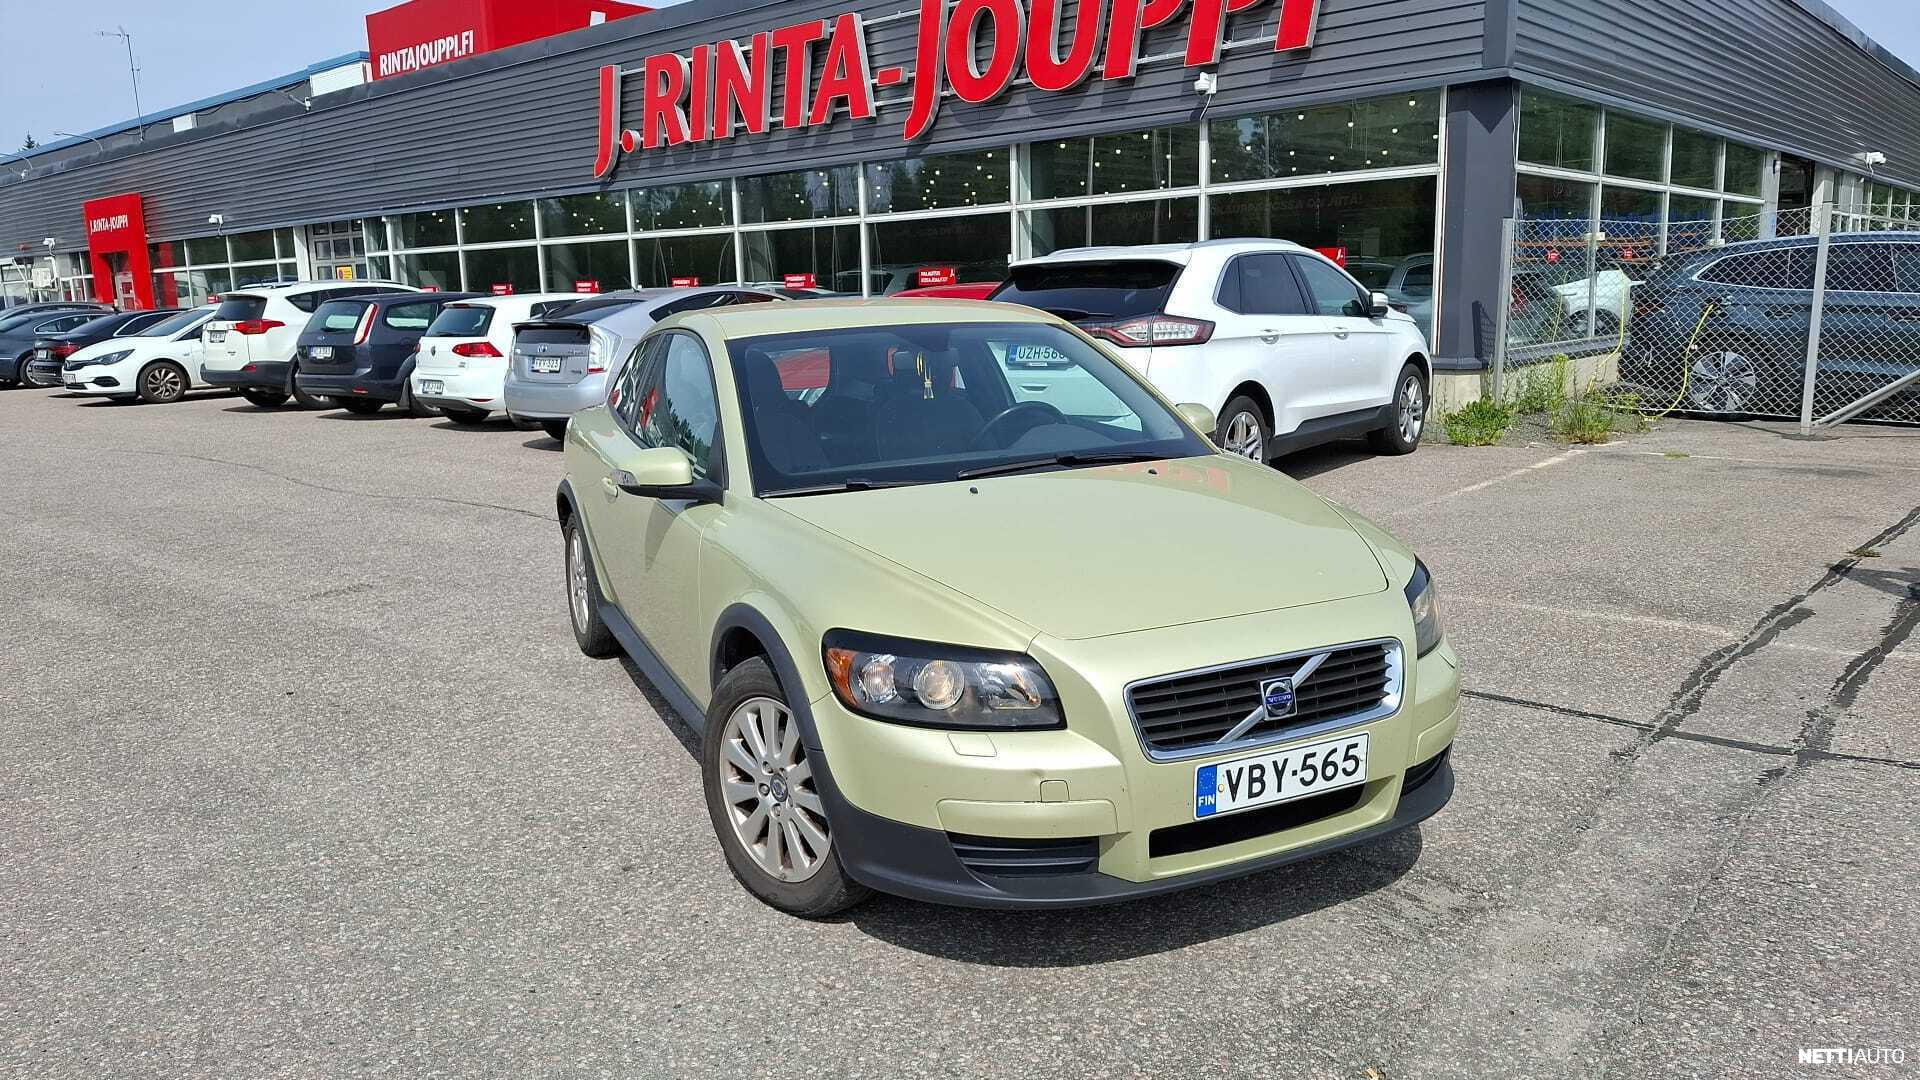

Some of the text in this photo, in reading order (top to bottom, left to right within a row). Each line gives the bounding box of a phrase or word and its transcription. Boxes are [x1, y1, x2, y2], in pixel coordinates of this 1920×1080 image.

[379, 29, 474, 77] RINTAJOUPPI.FI
[1267, 693, 1294, 704] VOLVO
[1198, 742, 1360, 807] FIN VBY-565
